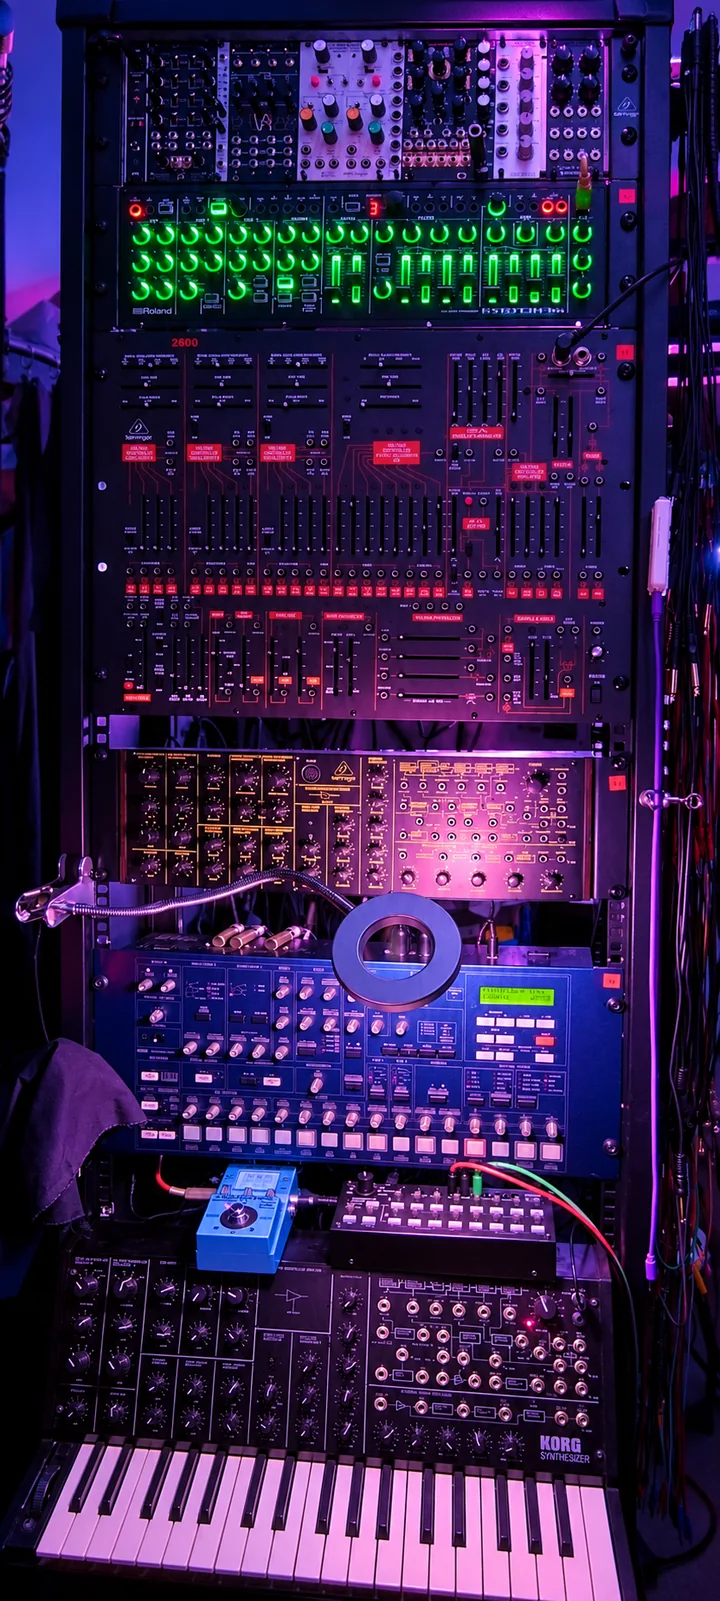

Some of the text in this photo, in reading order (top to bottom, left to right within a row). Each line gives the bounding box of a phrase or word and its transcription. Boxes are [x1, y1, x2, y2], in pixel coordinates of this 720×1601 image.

[369, 201, 378, 215] 3
[142, 307, 172, 315] Roland
[171, 337, 198, 348] 2600
[540, 1435, 582, 1453] KORG
[540, 1451, 590, 1464] SYNTHESIZER
